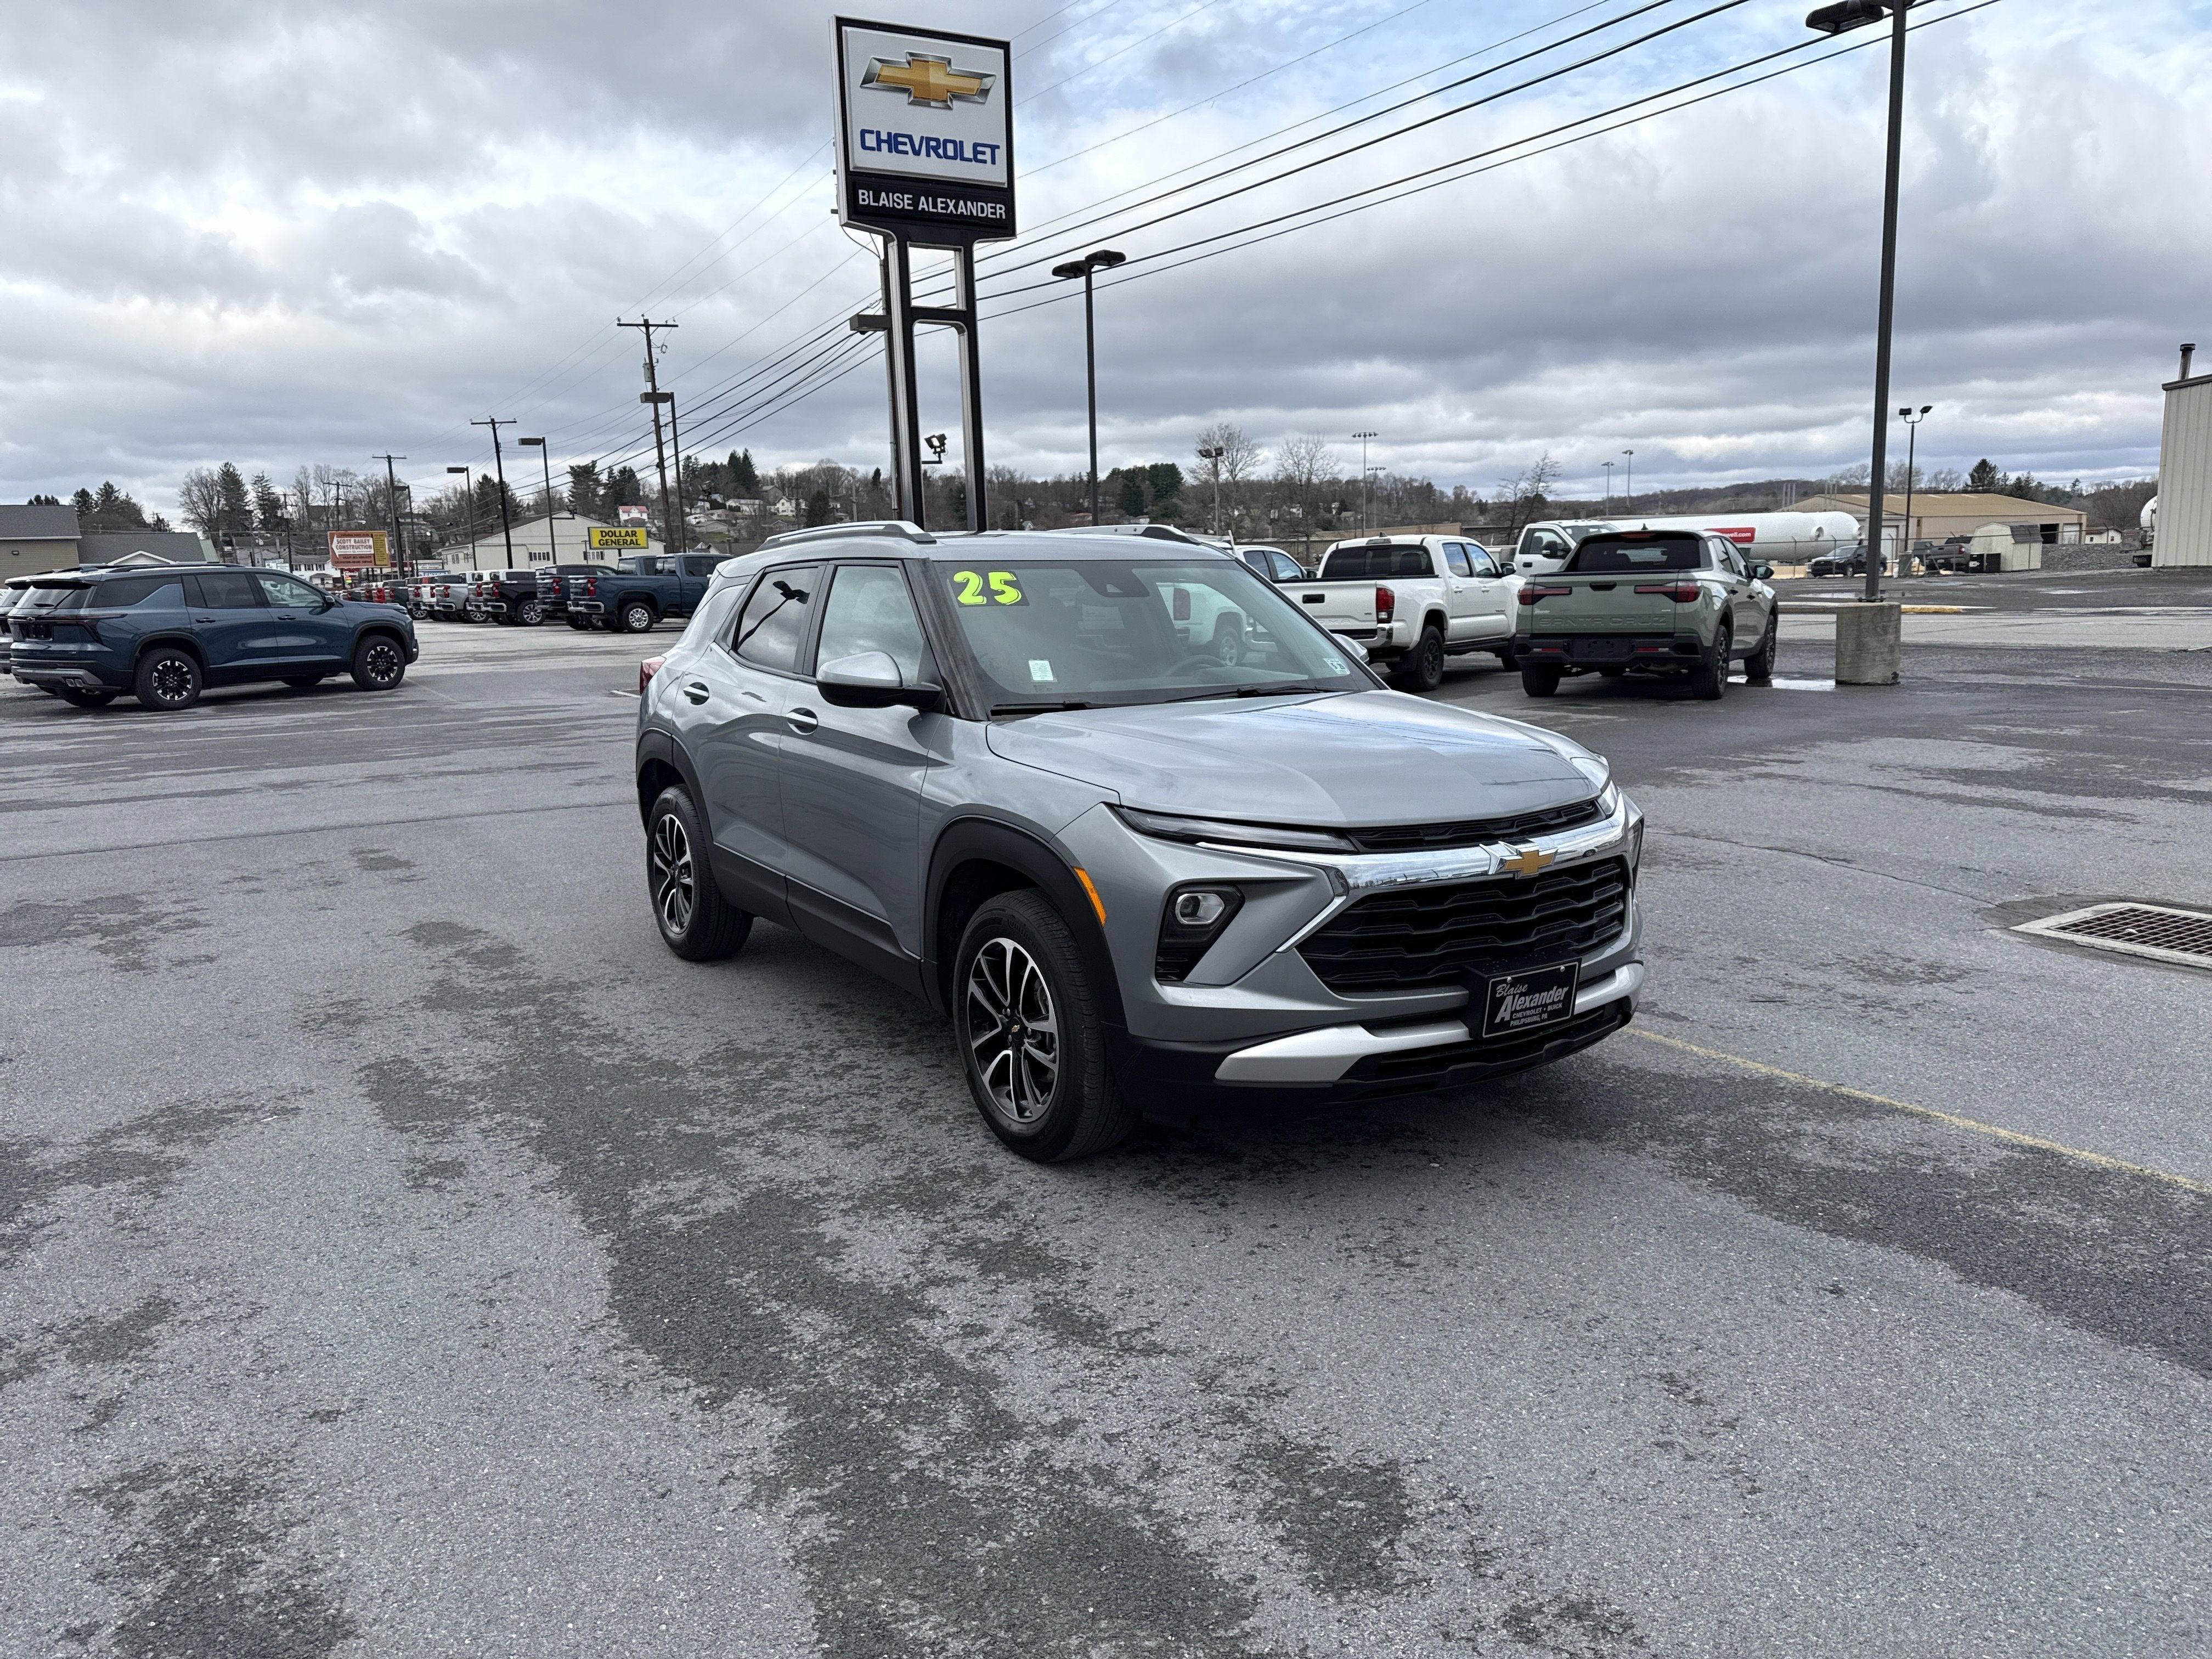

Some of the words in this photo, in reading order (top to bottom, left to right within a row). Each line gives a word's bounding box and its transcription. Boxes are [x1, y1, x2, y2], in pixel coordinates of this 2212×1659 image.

[860, 129, 1000, 165] CHEVROLET
[858, 189, 913, 210] BLAISE
[918, 196, 1006, 219] ALEXANDER
[598, 538, 641, 546] GENERAL
[953, 571, 1022, 605] 25
[1539, 617, 1604, 627] SANTA
[1609, 616, 1667, 626] CRUZ
[1496, 984, 1528, 998] Blaise
[1494, 986, 1569, 1023] Alexander
[1512, 1007, 1542, 1019] CHEVROLET
[1547, 1003, 1562, 1011] BUICK
